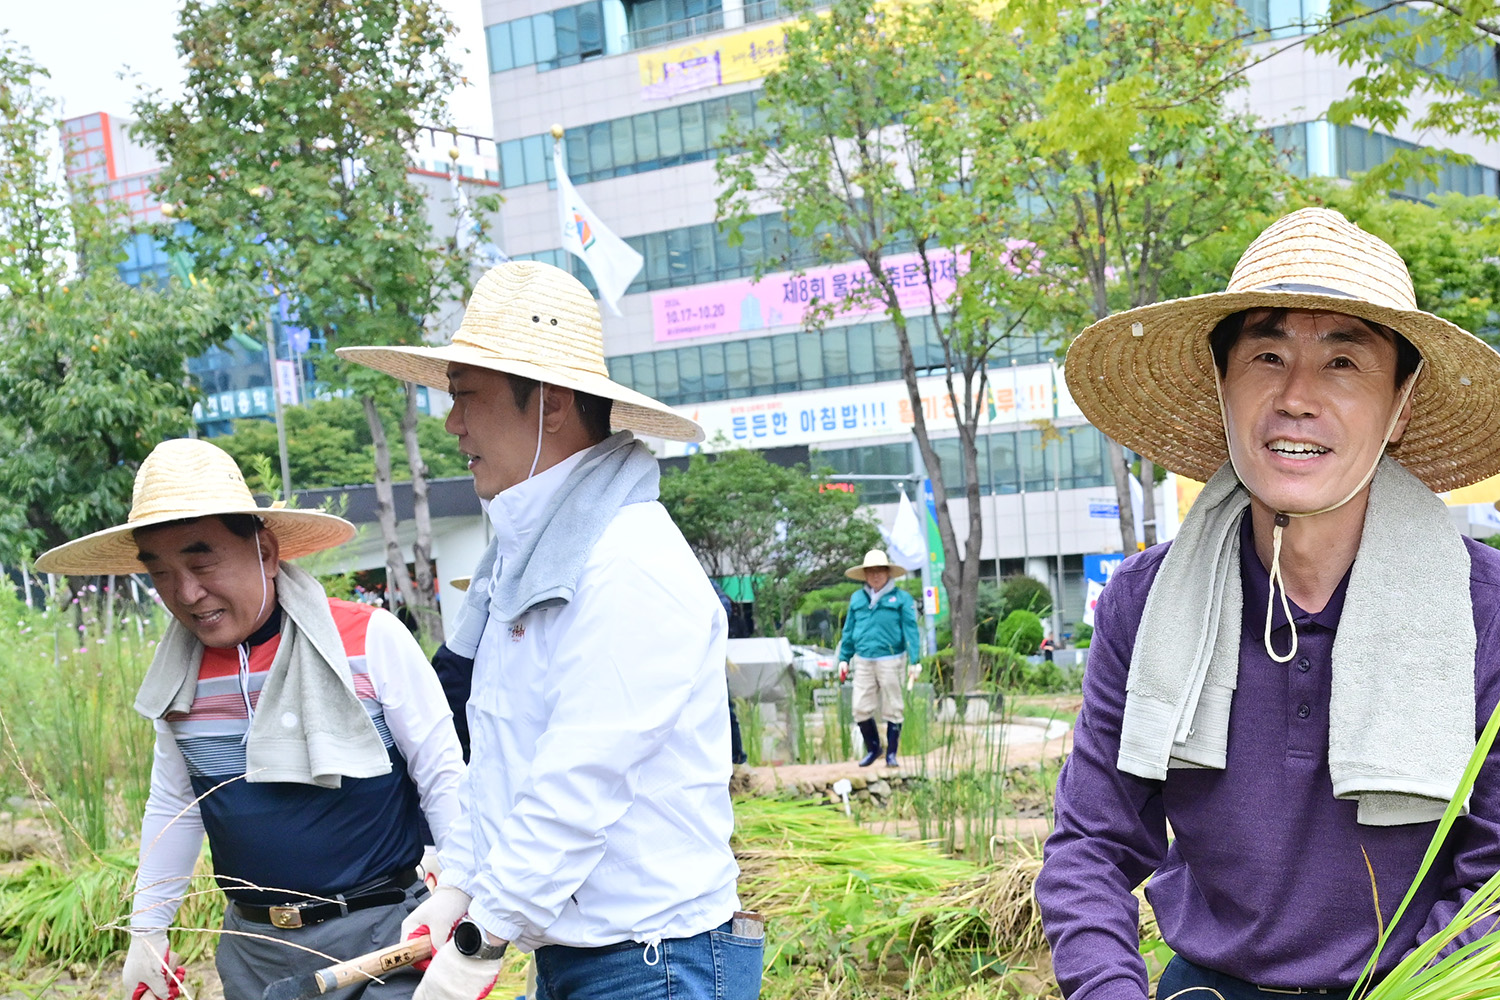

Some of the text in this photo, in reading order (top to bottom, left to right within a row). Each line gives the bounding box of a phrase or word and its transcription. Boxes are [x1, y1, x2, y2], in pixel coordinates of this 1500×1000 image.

[783, 276, 826, 304] 제8회
[832, 256, 957, 298] 울산축문화제
[732, 411, 788, 440] 든든한
[800, 402, 887, 433] 아침밥!!!
